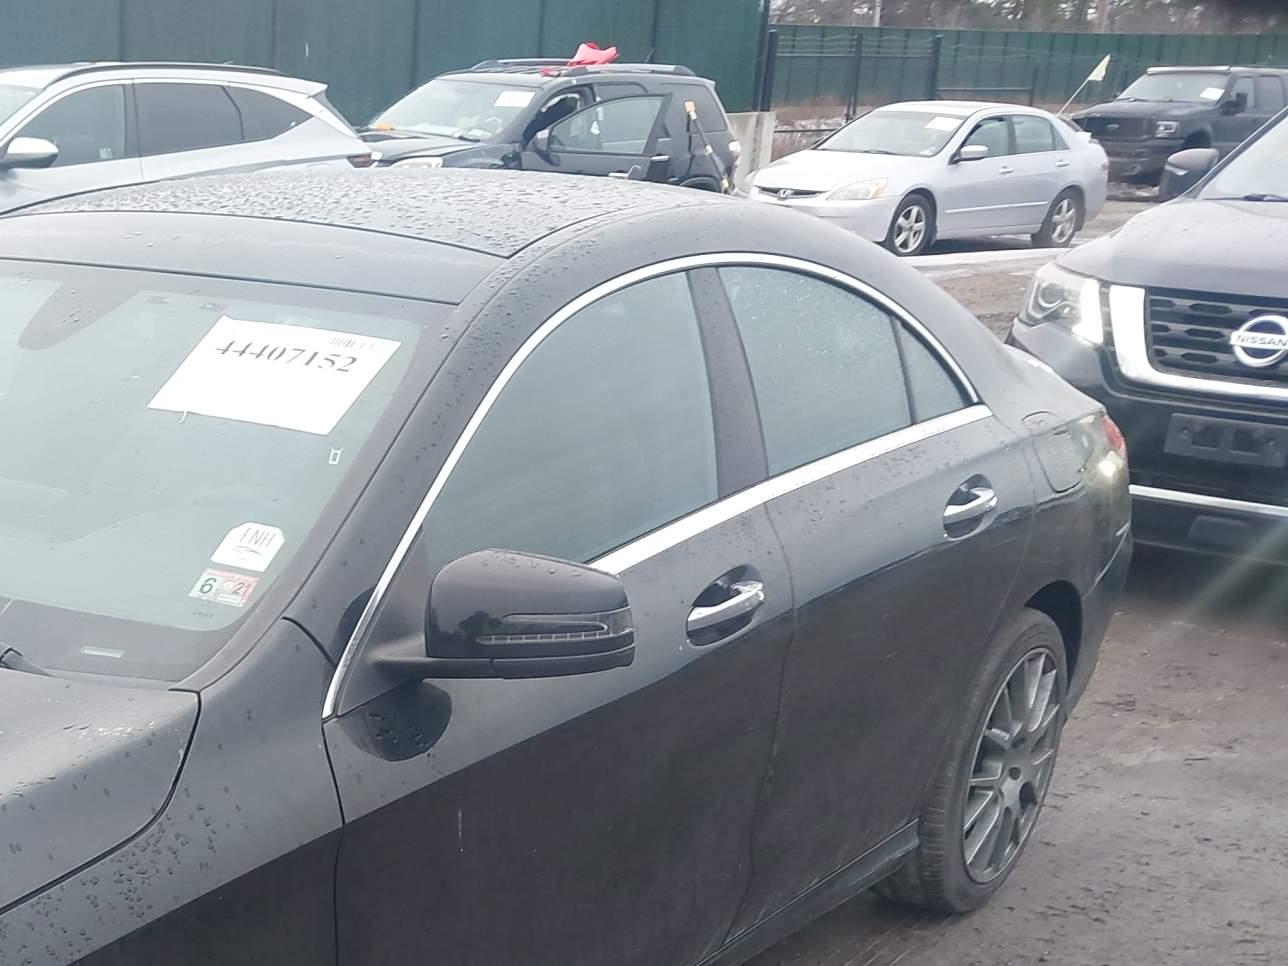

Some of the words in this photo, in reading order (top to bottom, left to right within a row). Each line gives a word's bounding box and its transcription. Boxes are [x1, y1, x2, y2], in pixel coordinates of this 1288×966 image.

[1236, 335, 1288, 346] NISSAN
[215, 340, 358, 373] 44407152
[200, 578, 216, 594] 6
